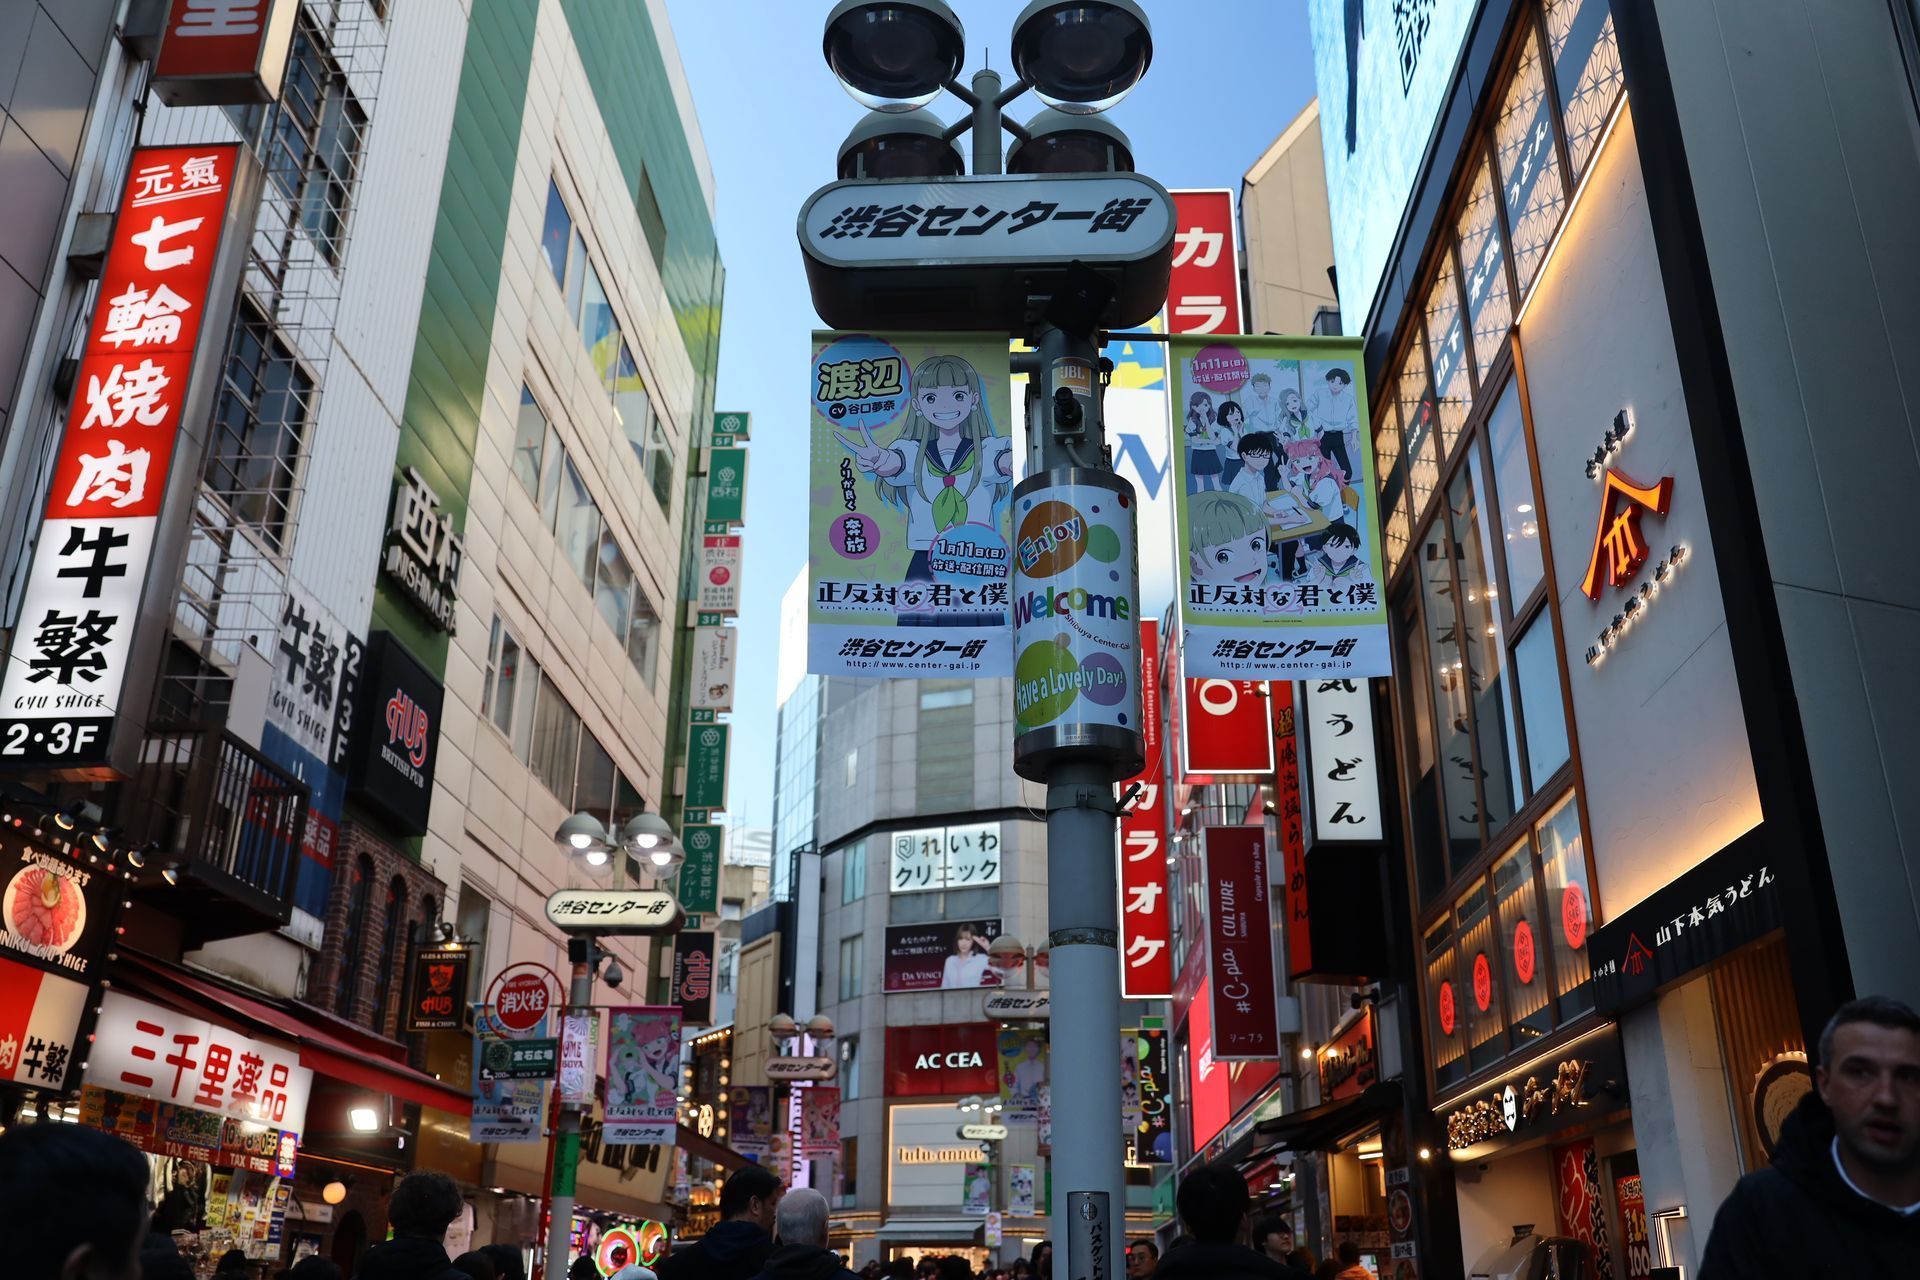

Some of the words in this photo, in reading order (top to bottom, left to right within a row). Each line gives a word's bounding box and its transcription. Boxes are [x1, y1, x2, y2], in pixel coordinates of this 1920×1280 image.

[135, 155, 220, 199] 元氣
[819, 198, 1152, 239] 渋谷センター街
[66, 216, 205, 508] 七輪焼肉
[1061, 366, 1085, 380] JBL
[817, 357, 903, 401] 渡辺
[848, 400, 895, 415] 谷口夢奈
[398, 466, 467, 600] 西村
[708, 524, 725, 533] 4F
[843, 517, 867, 553] 奔放
[1019, 516, 1081, 572] Enjoy
[25, 526, 129, 685] 牛繁
[396, 546, 458, 637] NISHIMURA
[817, 581, 1009, 606] 正反対な君と僕
[1189, 583, 1377, 606] 正反対な君と僕
[702, 616, 718, 625] 3F
[1014, 586, 1129, 630] Welcome
[1064, 613, 1092, 641] Shibuya
[280, 592, 339, 711] 牛繁
[838, 638, 988, 659] 渋谷センター街
[1212, 639, 1358, 659] 渋谷センター街
[14, 696, 47, 710] GYU
[55, 694, 104, 709] SHIGE
[1016, 677, 1039, 716] Have
[1040, 684, 1048, 699] a
[1050, 665, 1093, 692] Lovely
[1097, 666, 1123, 685] Day!
[273, 690, 295, 719] GYU
[297, 709, 328, 744] SHIGE
[386, 688, 428, 768] HUB
[694, 711, 711, 720] 2F
[381, 745, 410, 779] BRITISH
[409, 768, 424, 788] PUB
[689, 812, 705, 822] 1F
[921, 831, 998, 858] れいわ
[21, 846, 91, 888] 食べ放題あります
[699, 851, 714, 900] 渋谷西村
[896, 859, 998, 888] クリニック
[1125, 780, 1165, 968] カラオケ
[552, 900, 667, 917] 渋谷センター街
[1221, 880, 1235, 937] CULTURE
[1656, 866, 1775, 947] 山下本気うどん
[57, 952, 88, 973] SHIGE
[680, 951, 711, 1001] HUB
[902, 972, 916, 981] DA
[917, 971, 942, 980] VINCI
[421, 996, 453, 1015] HUB
[501, 989, 546, 1014] 消火栓
[23, 1035, 69, 1083] 牛繁
[121, 1020, 289, 1123] 三千里薬品
[915, 1053, 942, 1070] AC
[945, 1052, 983, 1068] CEA
[613, 1127, 666, 1137] 渋谷センター街
[166, 1141, 185, 1156] TAX
[188, 1145, 210, 1162] FREE
[230, 1153, 246, 1168] TAX
[250, 1157, 269, 1172] FREE
